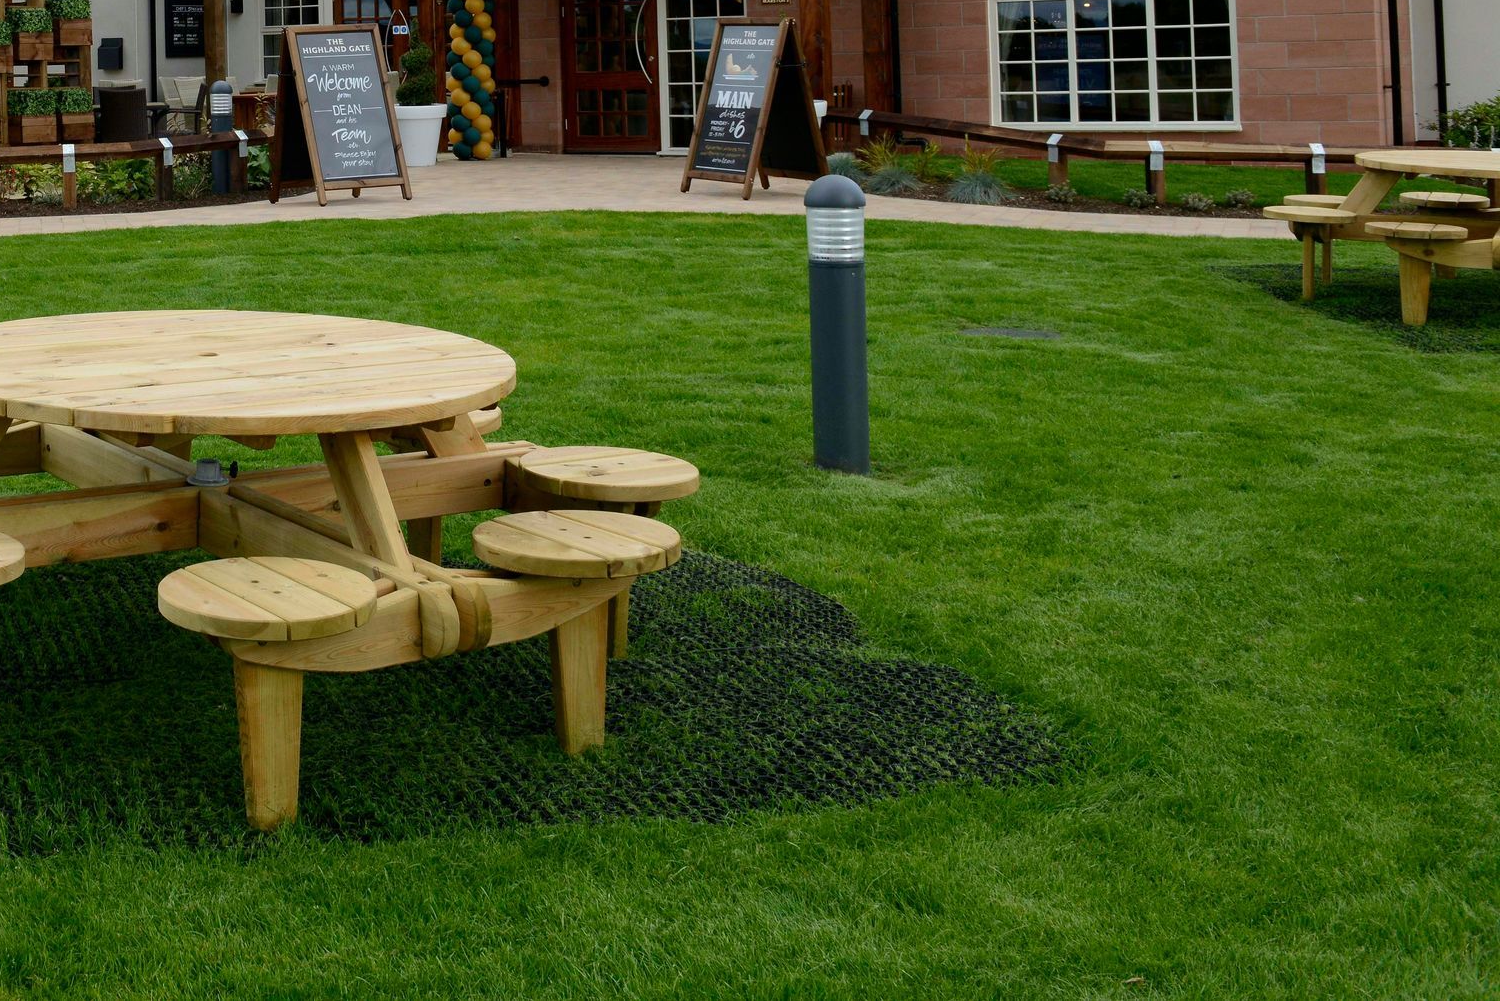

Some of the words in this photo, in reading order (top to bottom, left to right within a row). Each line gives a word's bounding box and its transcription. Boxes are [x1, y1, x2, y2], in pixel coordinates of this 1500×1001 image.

[744, 30, 757, 38] THE
[326, 38, 344, 46] THE
[723, 38, 757, 46] HIGHLAND
[302, 46, 347, 54] HIGHLAND
[348, 44, 371, 52] GATE
[329, 63, 355, 71] WARM
[307, 72, 373, 92] Welcome
[715, 90, 755, 109] MAIN
[332, 103, 362, 116] DEAN
[719, 109, 746, 119] dishes
[331, 128, 372, 145] Team
